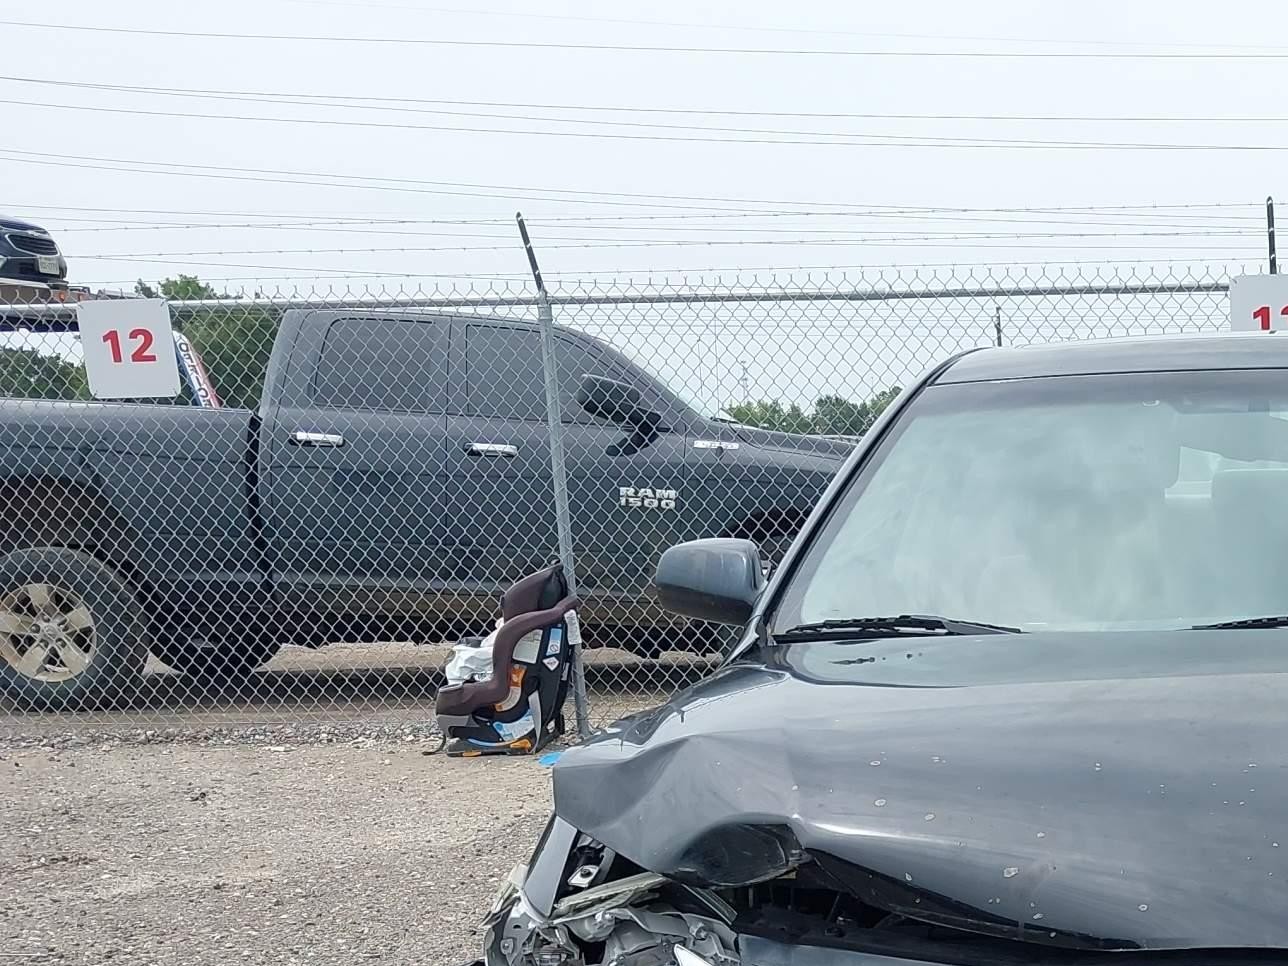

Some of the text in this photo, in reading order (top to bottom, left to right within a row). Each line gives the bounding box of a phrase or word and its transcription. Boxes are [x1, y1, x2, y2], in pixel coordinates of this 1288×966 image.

[102, 328, 157, 363] 12
[619, 487, 678, 499] RAM
[620, 497, 676, 509] 1500
